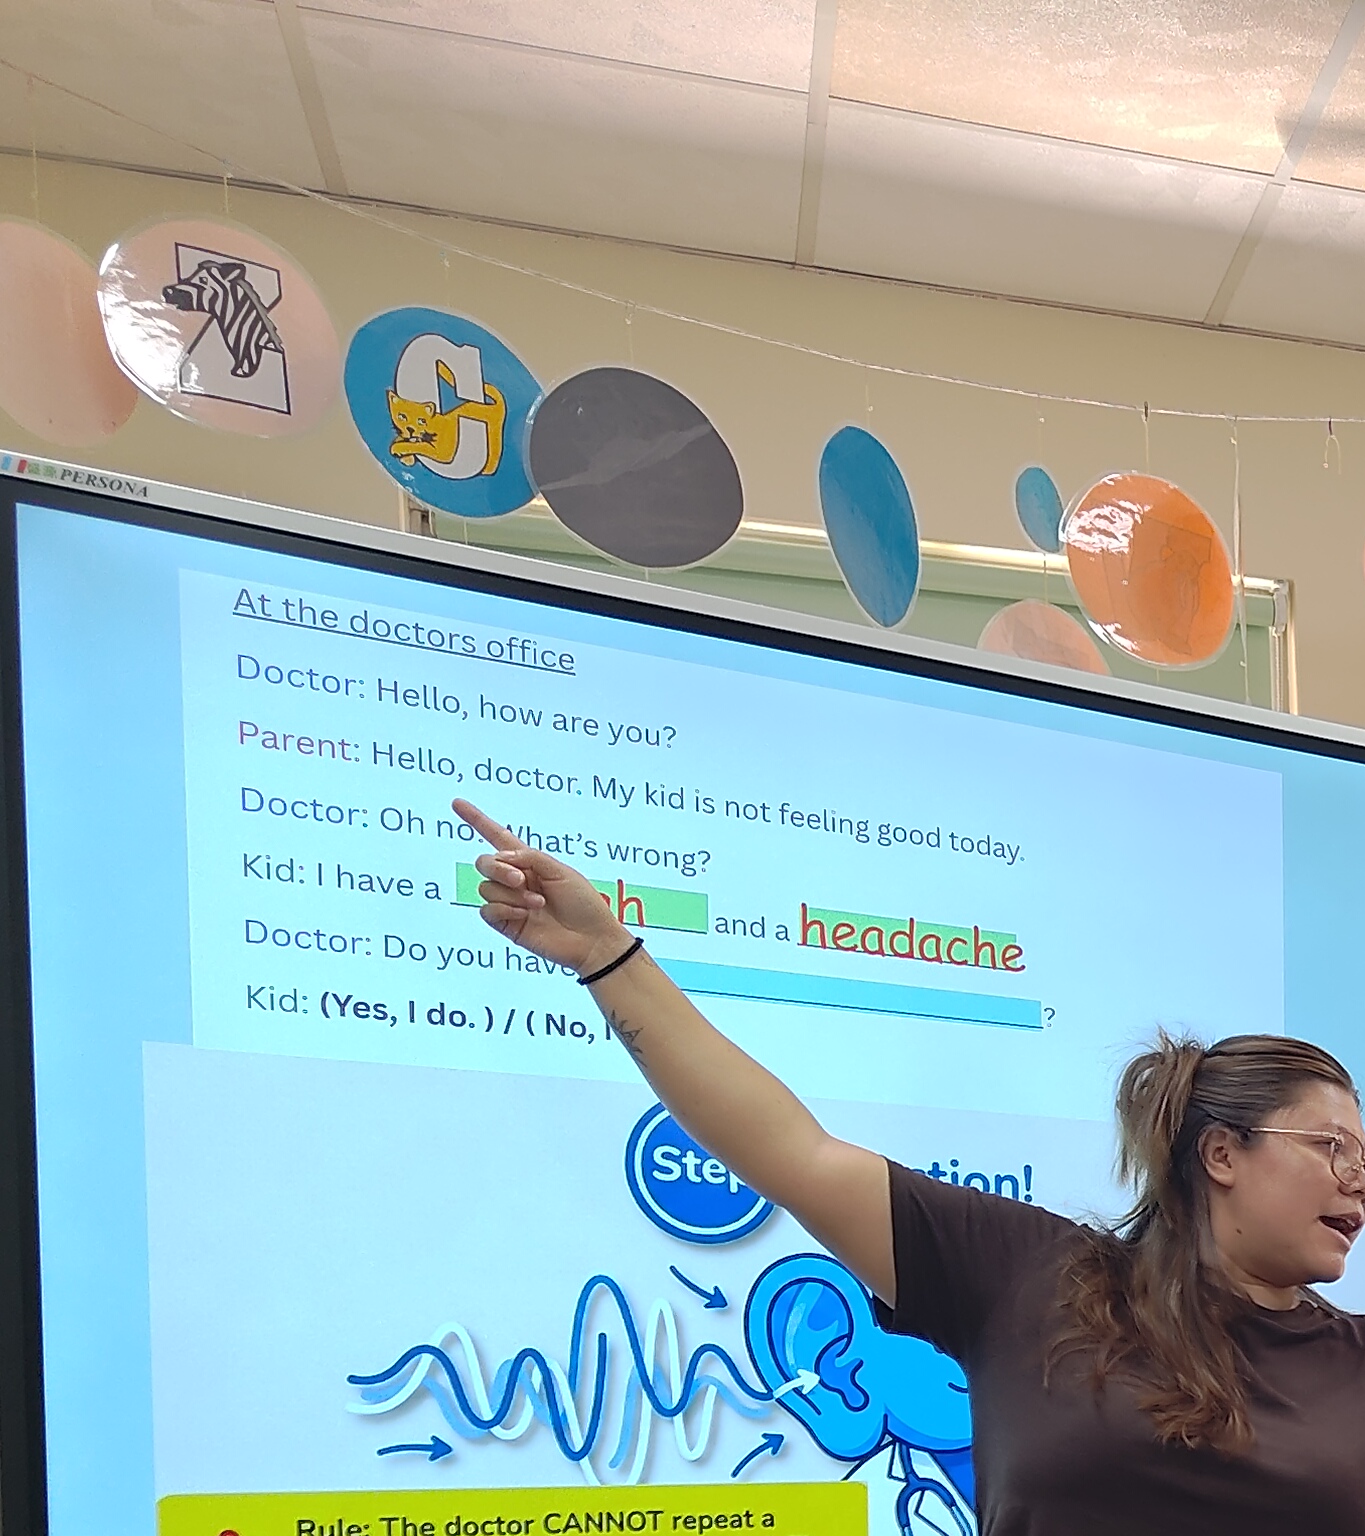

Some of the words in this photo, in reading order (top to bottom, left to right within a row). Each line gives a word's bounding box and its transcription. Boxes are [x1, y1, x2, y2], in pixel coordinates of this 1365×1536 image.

[60, 468, 149, 498] PERSONA
[233, 588, 272, 617] At
[281, 597, 339, 630] the
[349, 609, 477, 655] doctors
[486, 636, 576, 674] office
[236, 654, 365, 700] Doctor:
[377, 678, 470, 721] Hello,
[479, 694, 543, 728] how
[552, 709, 599, 739] are
[606, 720, 678, 750] you?
[238, 720, 361, 765] Parent:
[372, 743, 465, 782] Hello,
[473, 757, 582, 797] doctor.
[593, 775, 635, 809] My
[644, 782, 685, 812] kid
[694, 788, 716, 815] is
[725, 798, 771, 824] not
[778, 803, 870, 843] feeling
[877, 820, 941, 849] good
[949, 829, 1026, 867] today.
[240, 786, 369, 830] Doctor:
[379, 806, 425, 838] Oh
[606, 842, 711, 877] wrong?
[242, 854, 305, 887] Kid:
[316, 860, 323, 886] I
[336, 865, 414, 898] have
[424, 880, 442, 900] a
[714, 913, 766, 940] and
[774, 921, 790, 943] a
[800, 903, 1026, 971] headache
[244, 919, 372, 958] Doctor:
[383, 935, 427, 962] Do
[436, 946, 494, 973] you
[246, 985, 308, 1014] Kid:
[320, 991, 397, 1025] (Yes,
[409, 999, 415, 1022] I
[545, 1013, 595, 1044] No,
[543, 1509, 664, 1535] CANNOT
[671, 1509, 754, 1536] repeat
[762, 1512, 776, 1530] a
